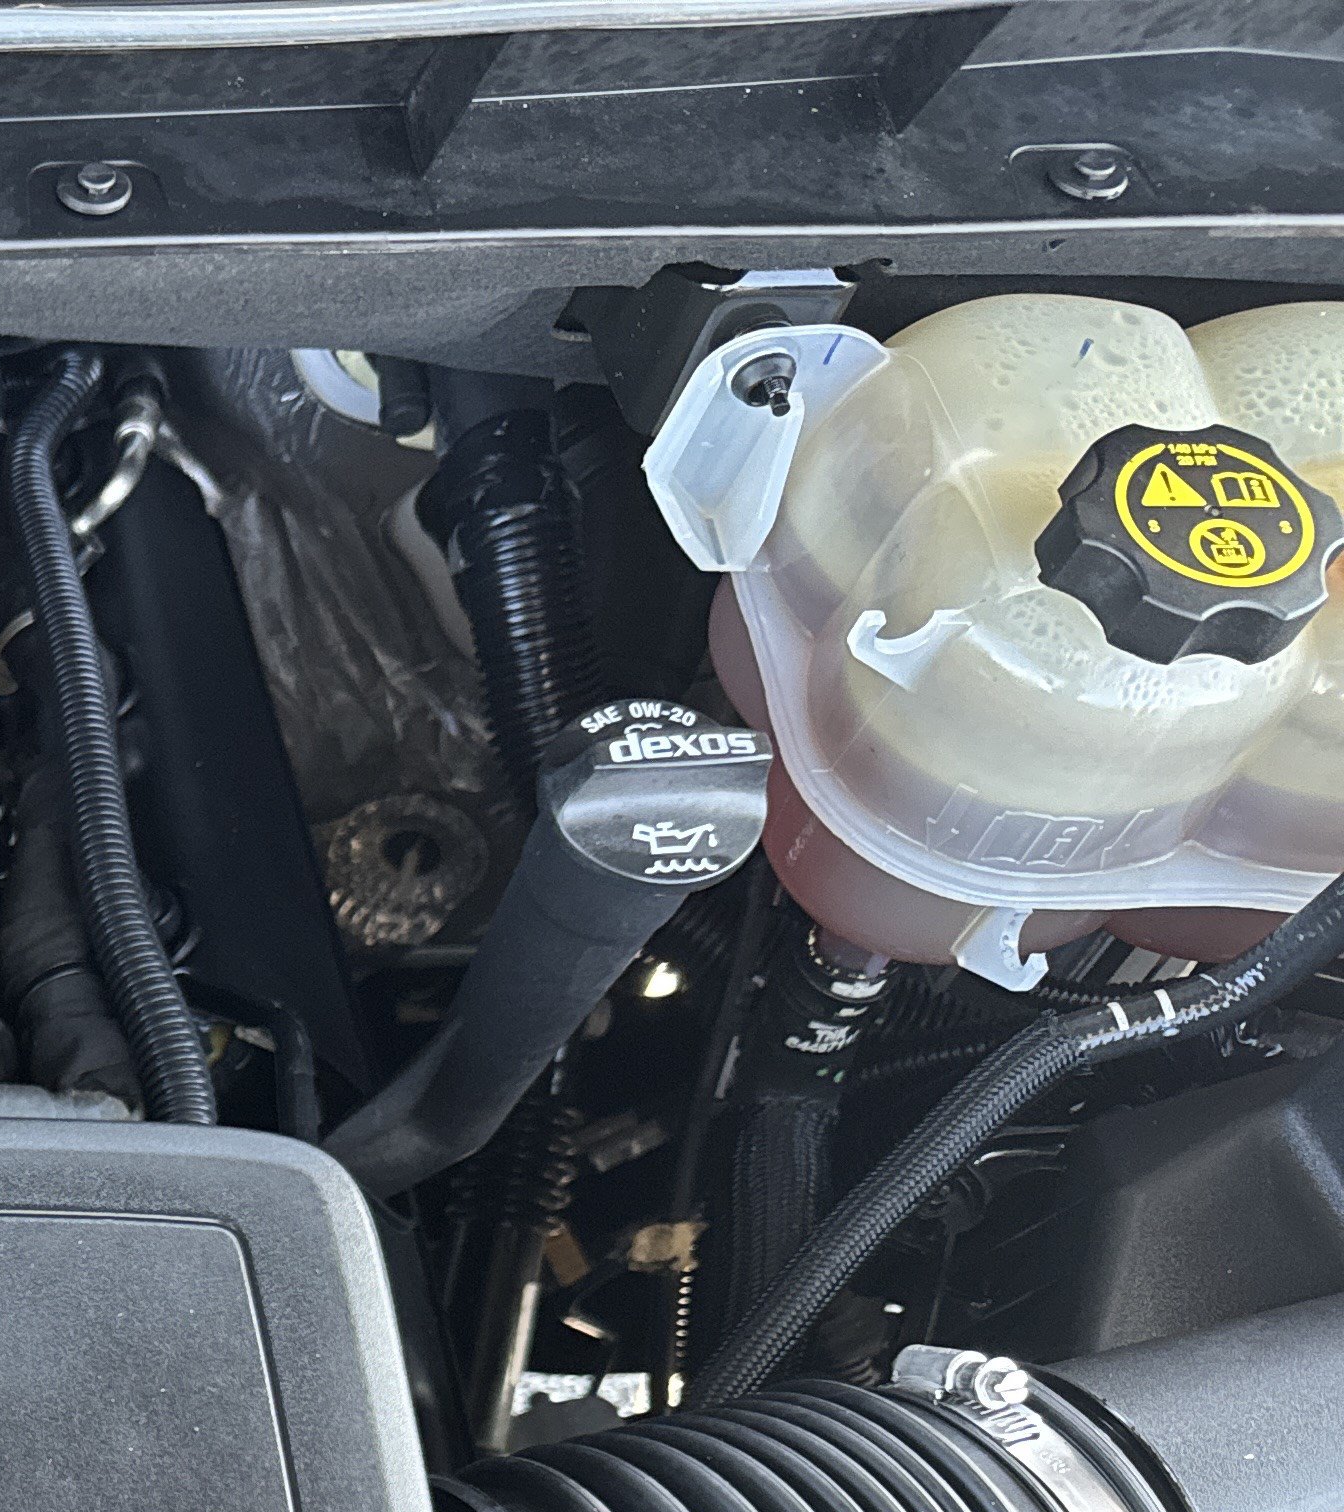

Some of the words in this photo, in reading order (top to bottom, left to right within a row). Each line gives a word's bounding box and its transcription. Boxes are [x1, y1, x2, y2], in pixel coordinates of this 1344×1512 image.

[580, 704, 623, 734] SAE
[628, 701, 697, 727] 0W-20
[608, 731, 757, 763] dexos
